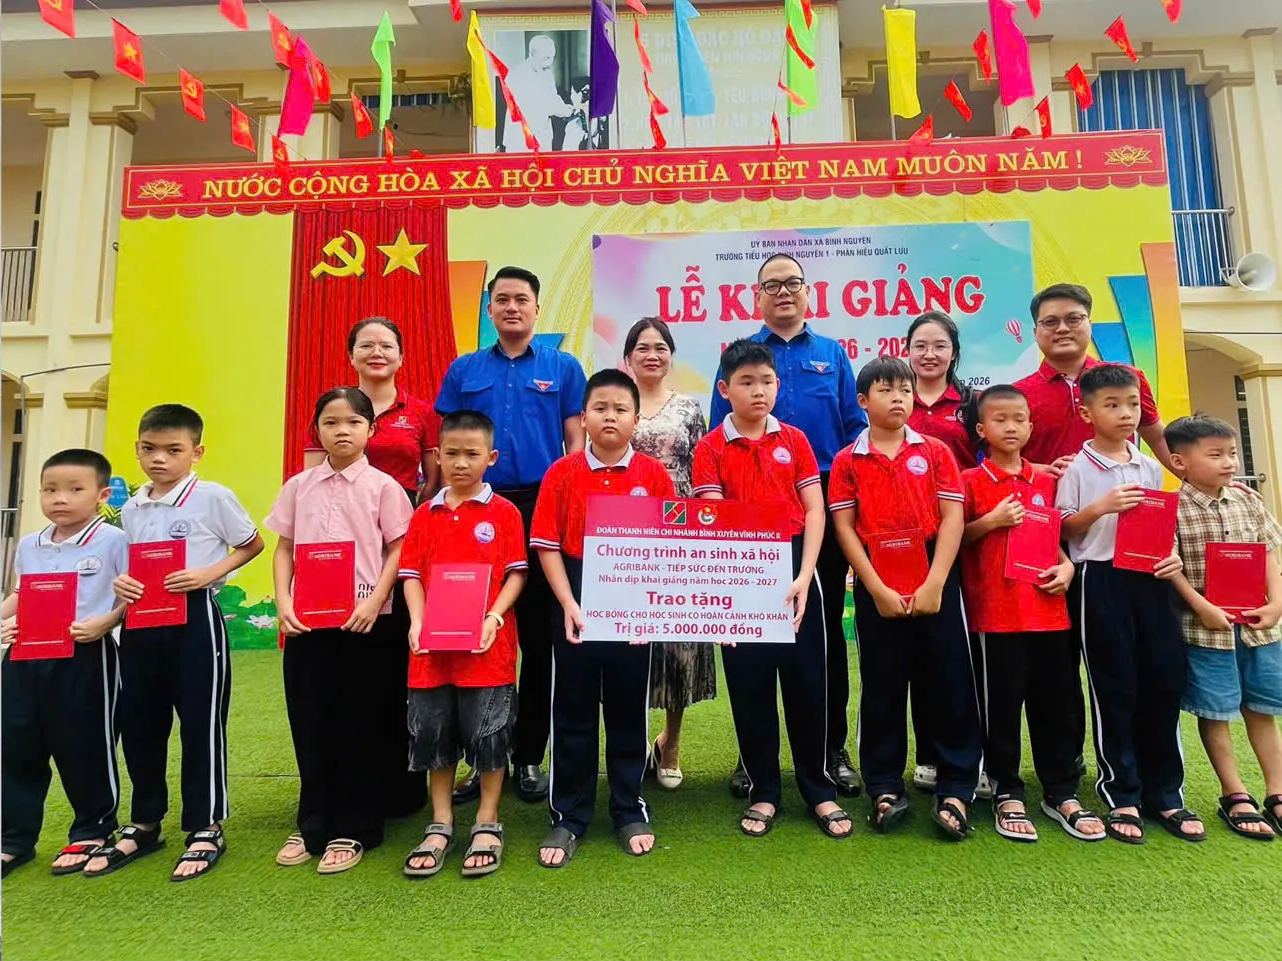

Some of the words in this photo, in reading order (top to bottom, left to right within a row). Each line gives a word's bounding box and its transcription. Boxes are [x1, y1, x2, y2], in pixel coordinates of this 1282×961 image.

[203, 172, 281, 199] NƯỚC
[289, 167, 369, 200] CỘNG
[378, 168, 440, 193] HÒA
[451, 164, 489, 189] XÃ
[501, 163, 554, 192] HỘI
[563, 157, 623, 187] CHỦ
[633, 157, 730, 185] NGHĨA
[744, 154, 810, 187] VIỆT
[818, 156, 892, 179] NAM
[897, 148, 992, 177] MUÔN
[999, 145, 1068, 171] NĂM
[762, 240, 776, 248] BAN
[825, 250, 829, 258] 1
[656, 264, 707, 323] LỄ
[841, 263, 986, 319] GIẢNG
[968, 377, 990, 386] 2026
[597, 526, 617, 535] ĐOÀN
[618, 527, 642, 536] THANH
[643, 526, 660, 536] NIÊN
[673, 527, 699, 537] NHÁNH
[700, 528, 715, 538] BÌNH
[717, 528, 739, 538] XUYÊN
[757, 529, 775, 539] PHÚC
[597, 544, 651, 561] Chương
[654, 545, 687, 559] trình
[691, 550, 707, 560] an
[710, 546, 737, 560] sinh
[741, 547, 757, 561] xã
[759, 548, 780, 564] hội
[614, 563, 660, 572] AGRIBANK
[667, 562, 686, 573] TIẾP
[688, 563, 706, 573] SỨC
[707, 563, 726, 574] ĐẾN
[728, 564, 764, 574] TRƯỜNG
[599, 574, 623, 583] Nhân
[624, 575, 639, 585] dịp
[641, 575, 661, 584] khai
[662, 575, 688, 586] giảng
[690, 576, 709, 585] năm
[711, 577, 726, 586] học
[756, 578, 777, 586] 2027
[646, 591, 686, 606] Trao
[692, 591, 733, 610] tặng
[630, 611, 648, 619] CHO
[668, 611, 687, 620] SINH
[701, 610, 724, 620] HOÀN
[748, 610, 765, 620] KHÓ
[615, 622, 631, 637] Trị
[635, 623, 659, 636] giá:
[662, 623, 726, 635] 5.000.000
[729, 623, 763, 637] đồng
